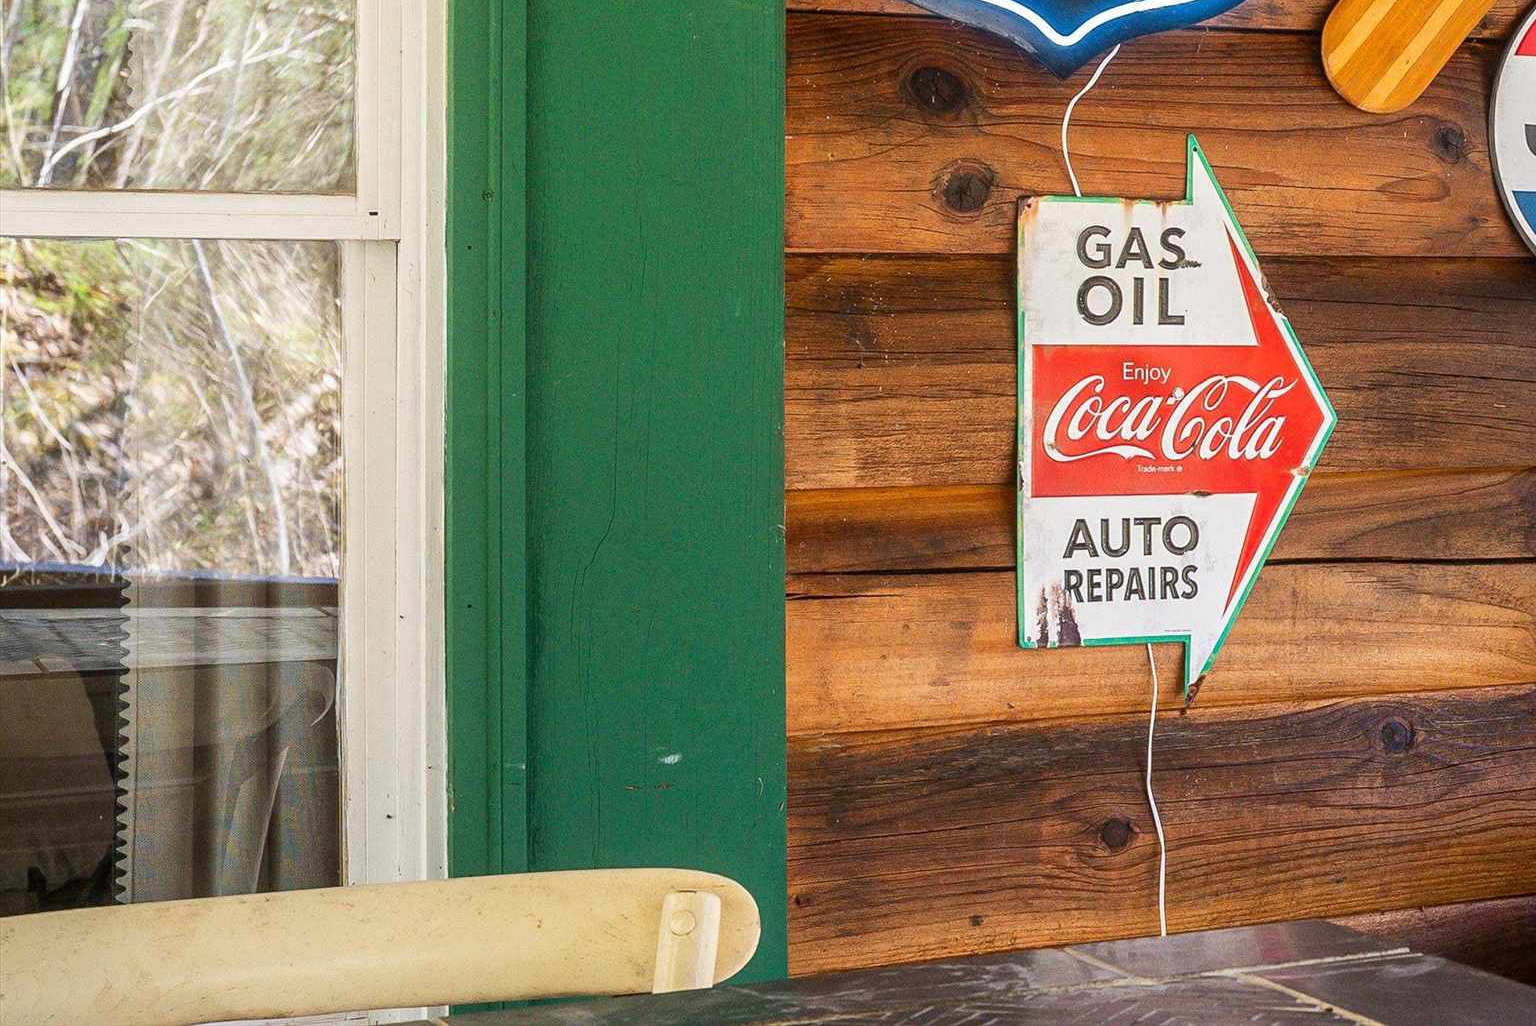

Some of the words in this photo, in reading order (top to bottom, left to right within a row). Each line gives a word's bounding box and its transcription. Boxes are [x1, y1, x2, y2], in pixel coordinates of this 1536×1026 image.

[1076, 224, 1187, 270] GAS
[1076, 275, 1186, 326] OIL
[1123, 362, 1171, 384] Enjoy
[1063, 515, 1199, 558] AUTO
[1064, 565, 1199, 603] REPAIRS
